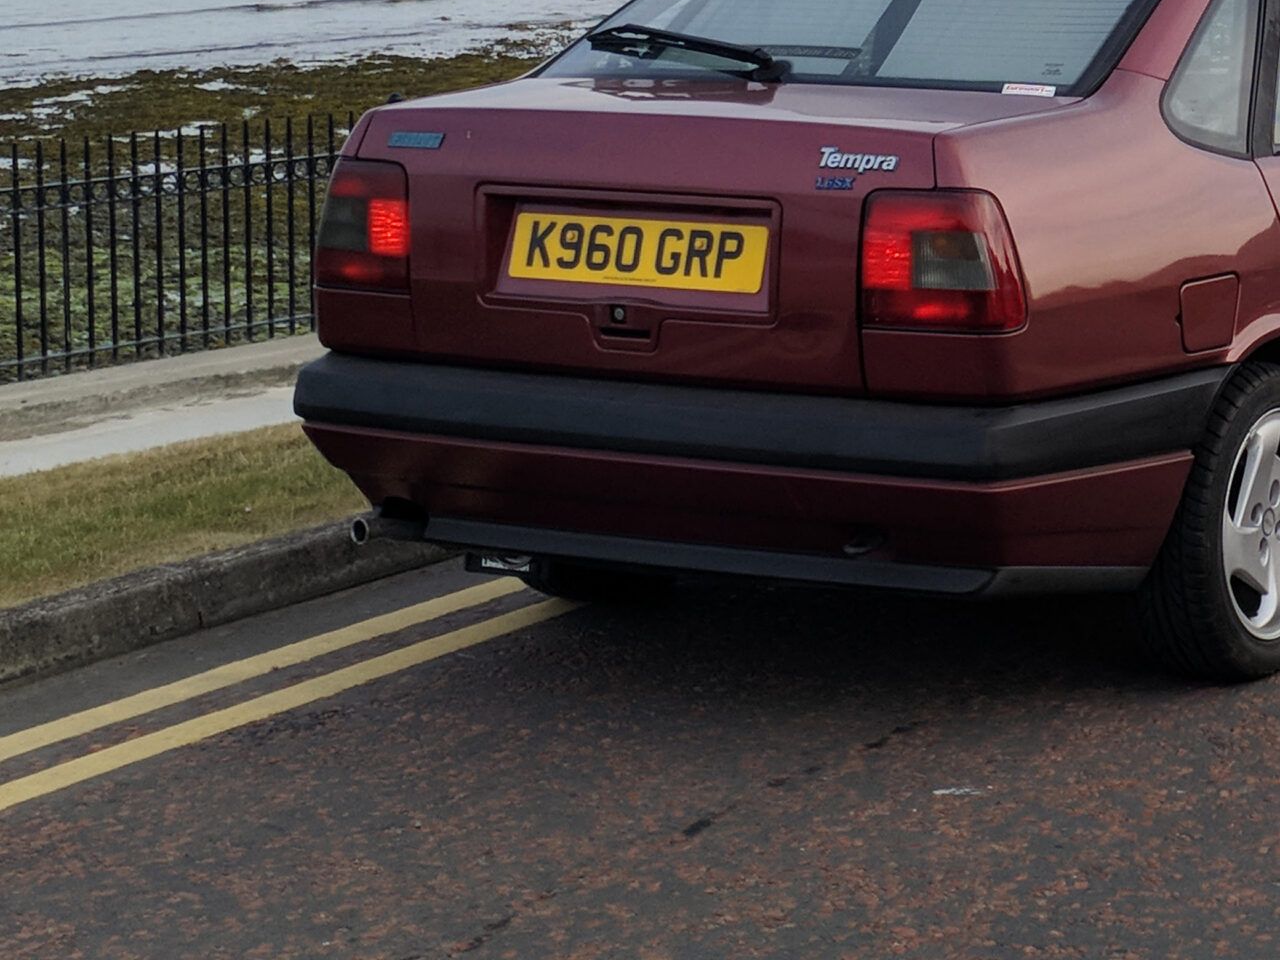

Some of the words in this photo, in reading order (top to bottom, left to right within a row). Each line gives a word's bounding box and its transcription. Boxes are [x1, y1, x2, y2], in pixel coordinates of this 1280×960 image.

[819, 146, 898, 173] Tempra
[526, 220, 644, 273] K960
[655, 228, 745, 279] GRP
